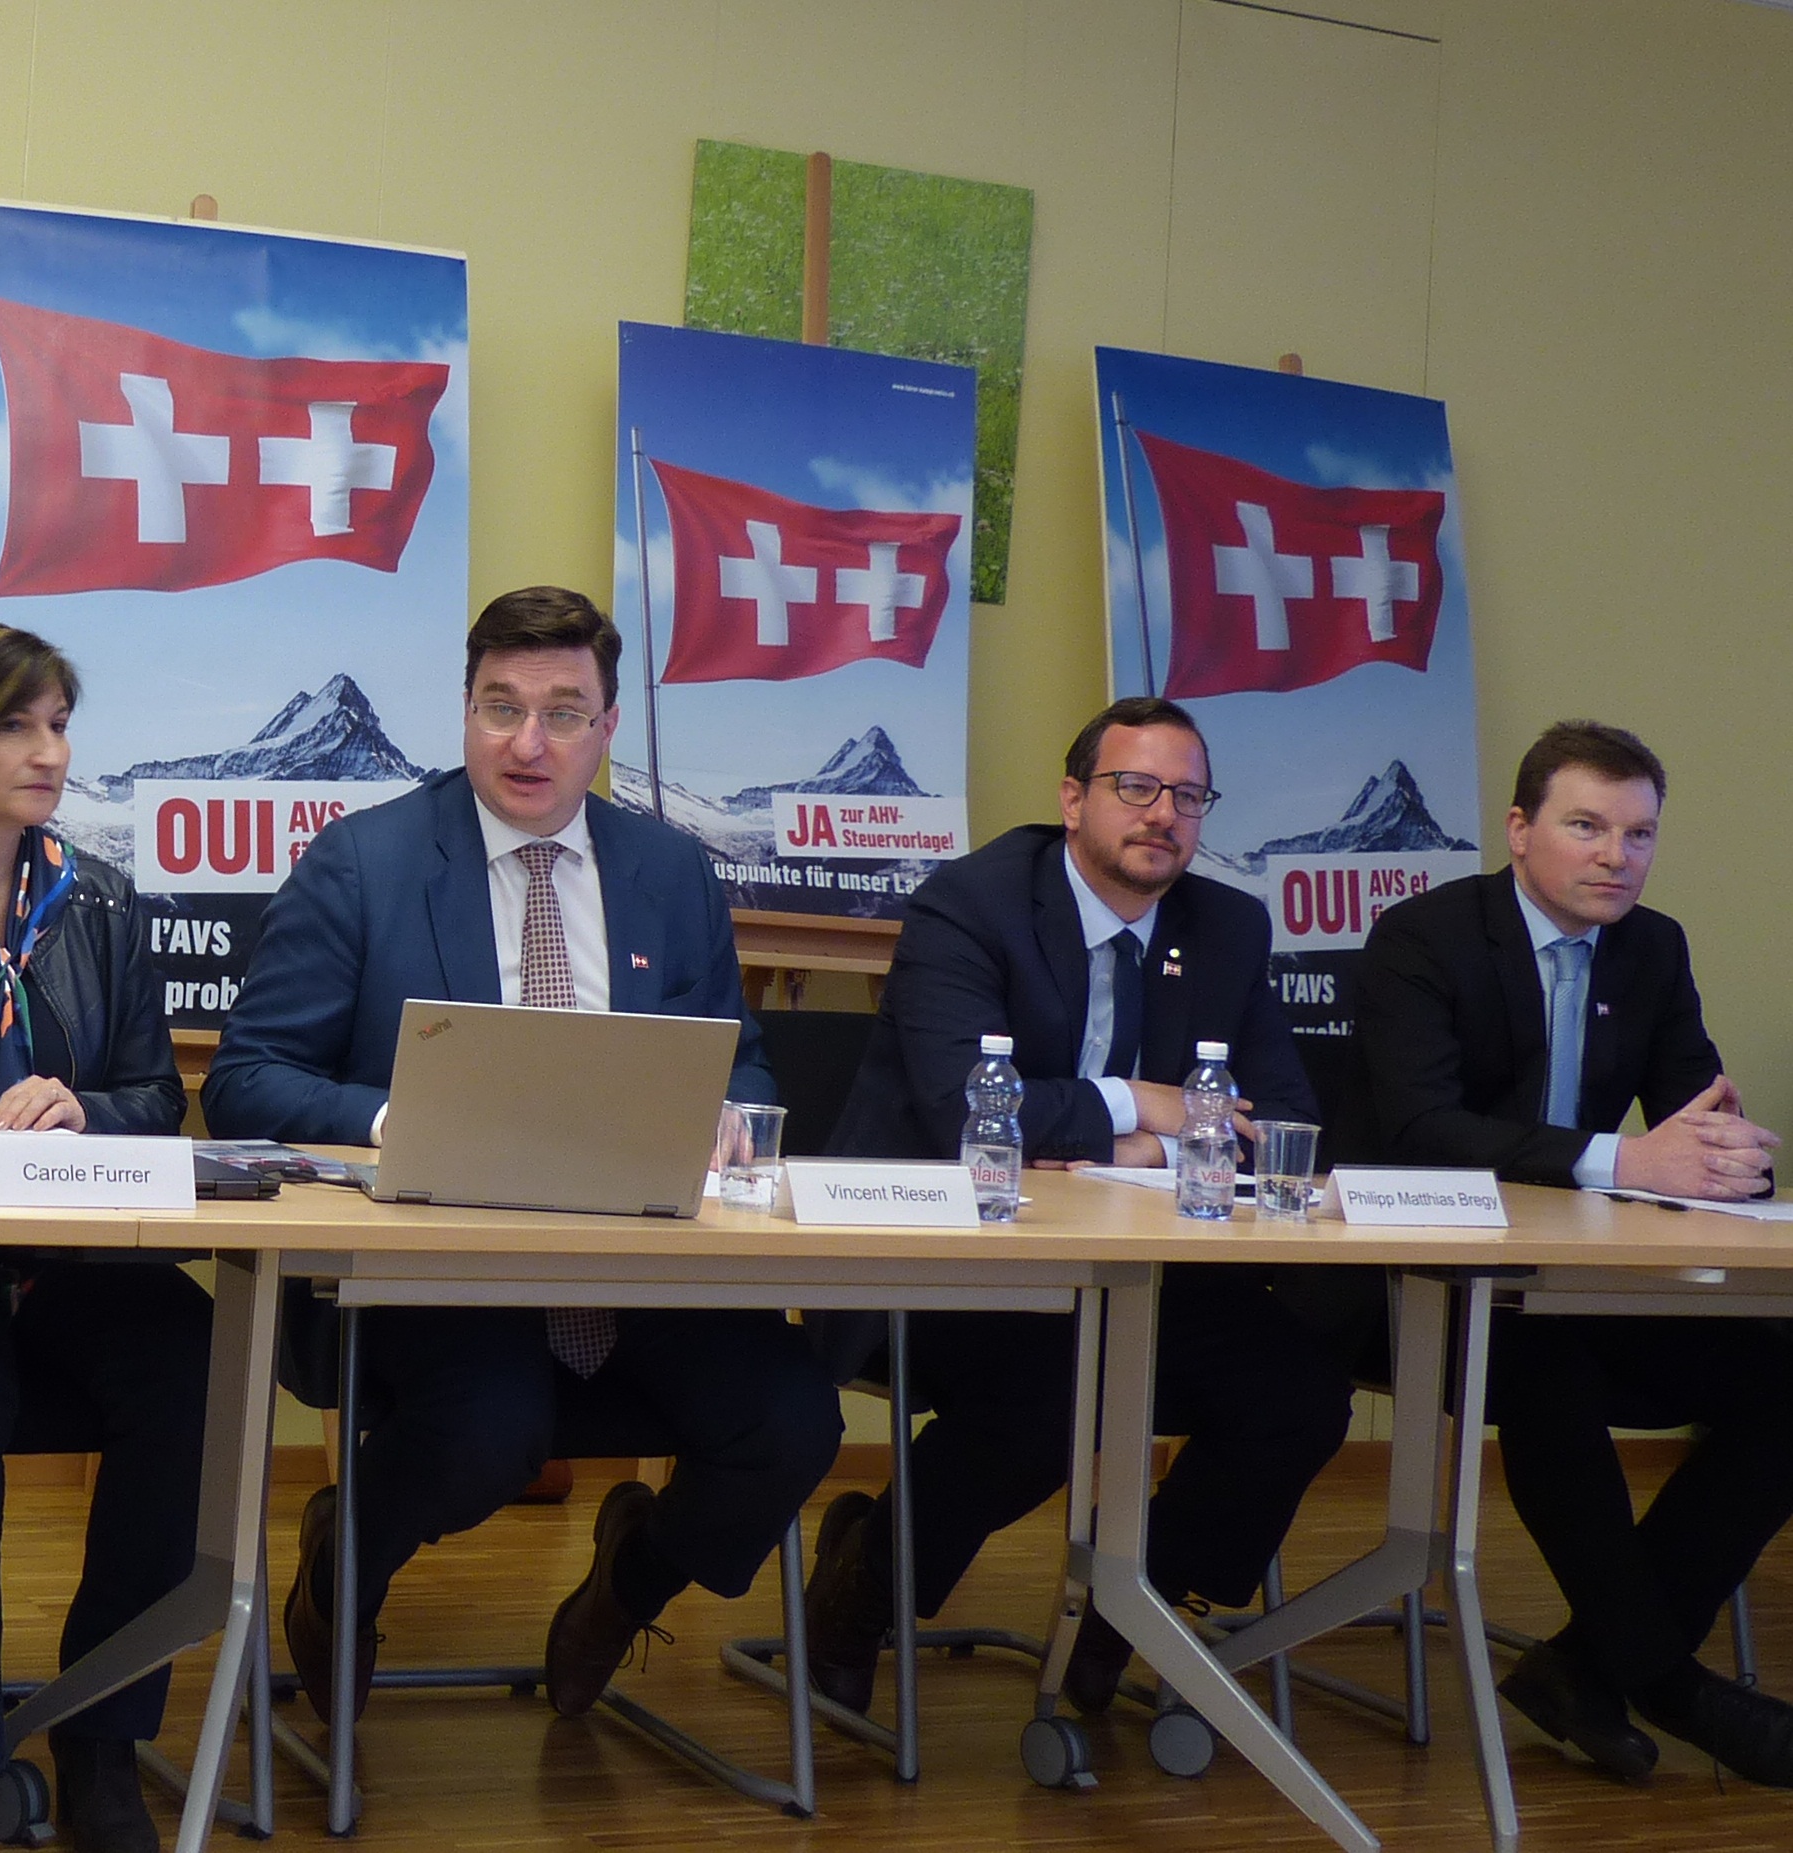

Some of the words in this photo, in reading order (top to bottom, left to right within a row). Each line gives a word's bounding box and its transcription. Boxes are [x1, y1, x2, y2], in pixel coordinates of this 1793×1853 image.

[289, 801, 346, 833] AVS
[787, 804, 837, 848] JA
[840, 809, 864, 823] zur
[868, 805, 904, 824] AHV-
[157, 798, 274, 875] OUI
[842, 829, 954, 853] Steuervorlage!
[713, 862, 803, 885] uspunkte
[805, 865, 834, 888] für
[838, 872, 890, 893] unser
[1370, 869, 1405, 896] AVS
[1410, 871, 1429, 895] et
[1283, 869, 1362, 936] OUI
[151, 918, 231, 956] l'AVS
[165, 977, 245, 1016] prob
[1282, 973, 1335, 1004] l'AVS
[23, 1163, 86, 1182] Carole
[93, 1165, 151, 1183] Furrer
[1201, 1168, 1235, 1184] vala
[825, 1184, 887, 1201] Vincent
[891, 1185, 948, 1202] Riesen
[1347, 1190, 1395, 1208] Philipp
[1397, 1191, 1455, 1207] Matthias
[1458, 1192, 1498, 1210] Bregy
